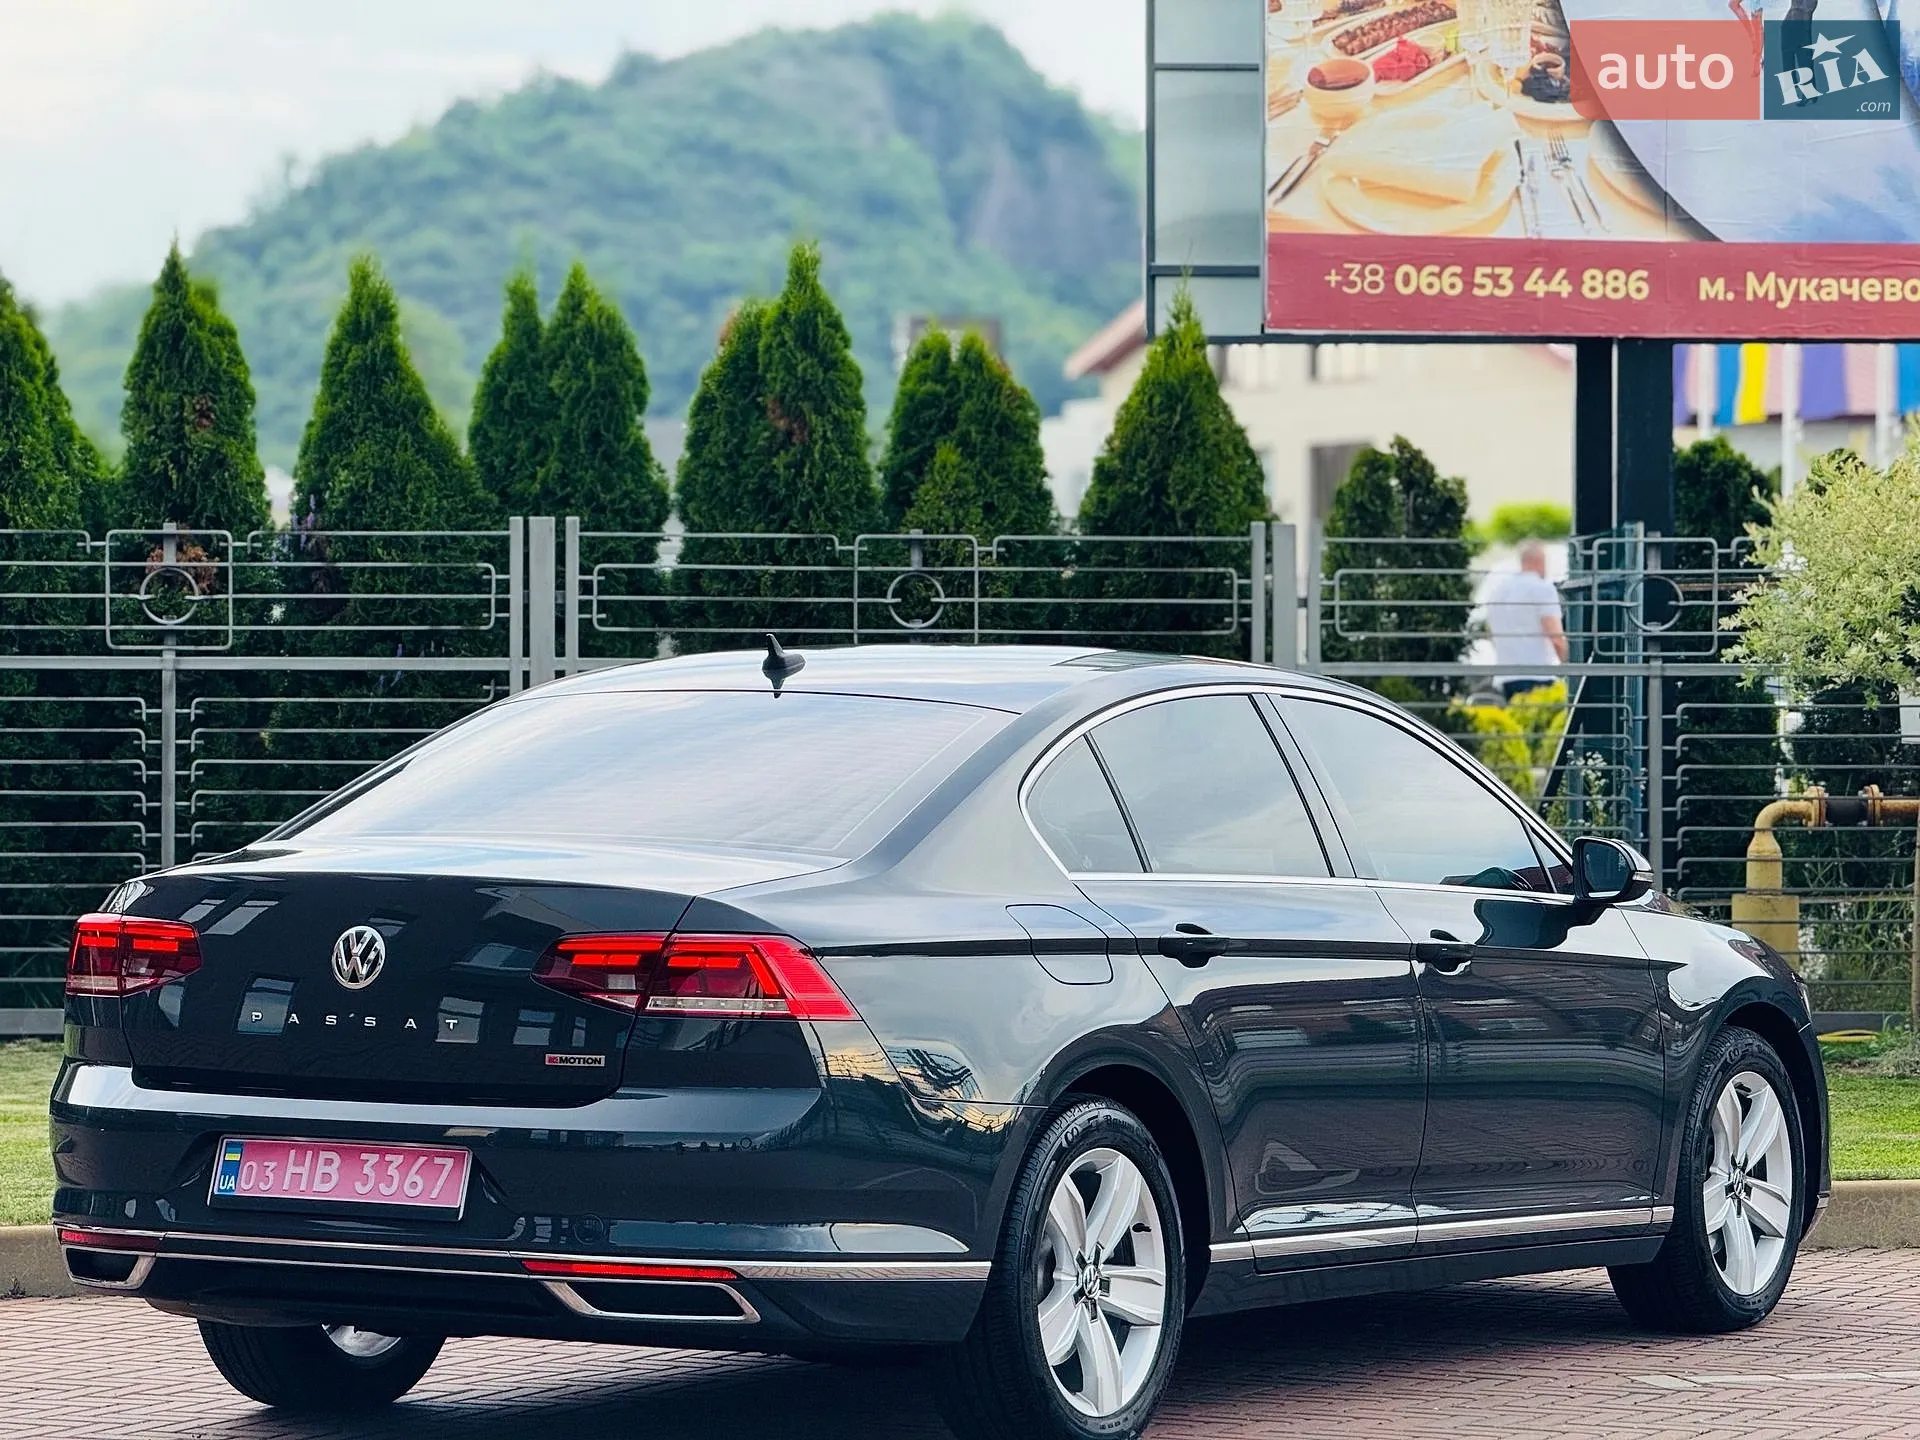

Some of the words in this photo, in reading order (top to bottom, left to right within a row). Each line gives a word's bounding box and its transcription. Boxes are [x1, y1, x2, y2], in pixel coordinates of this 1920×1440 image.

[1324, 263, 1385, 295] +38
[1394, 264, 1464, 296] 066
[1472, 266, 1514, 297] 53
[1523, 267, 1573, 298] 44
[1580, 268, 1650, 300] 886
[1699, 277, 1735, 301] м.
[1745, 271, 1920, 309] Мукачево
[332, 926, 386, 989] VW
[251, 1011, 459, 1031] PASSAT
[219, 1174, 236, 1191] UA
[240, 1160, 278, 1192] 03
[282, 1149, 341, 1193] HB
[354, 1152, 454, 1199] 3367
